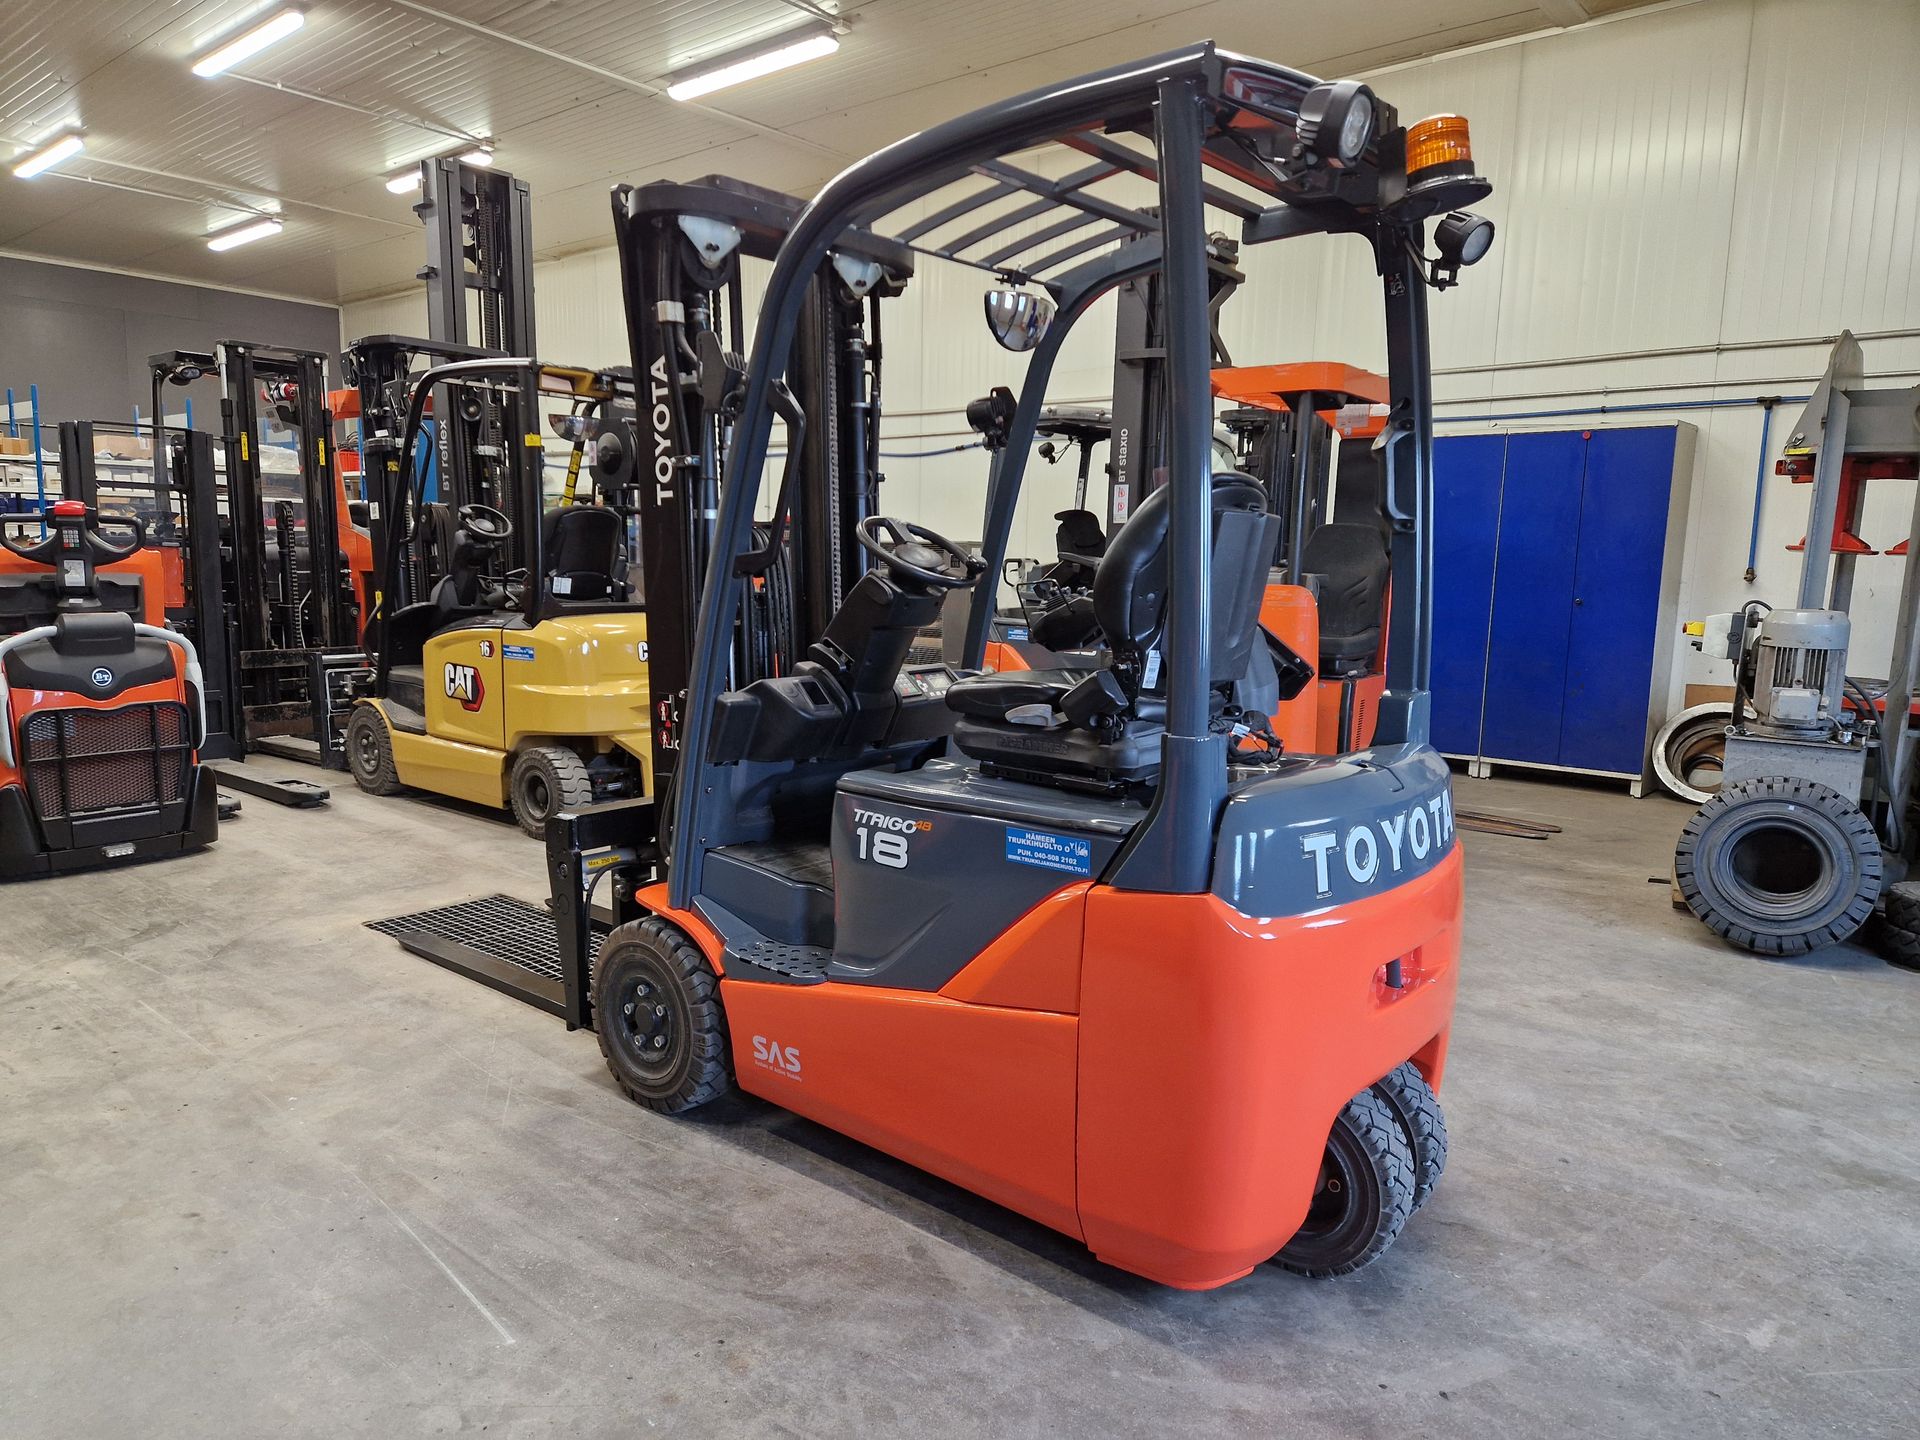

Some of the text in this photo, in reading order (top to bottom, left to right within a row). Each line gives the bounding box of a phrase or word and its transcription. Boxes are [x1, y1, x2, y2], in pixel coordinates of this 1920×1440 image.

[650, 354, 674, 507] TOYOTA
[439, 419, 450, 491] BT reflex
[1118, 469, 1126, 482] BT
[480, 641, 490, 657] 16
[445, 663, 475, 701] CAT
[856, 826, 908, 869] 18
[1008, 835, 1063, 853] TRUKKIHUOLTO
[1017, 848, 1033, 857] PUH.
[1061, 856, 1077, 865] 2102
[1026, 832, 1056, 844] HÄMEEN
[1301, 788, 1454, 894] TOYOTA
[752, 1035, 801, 1073] SAS
